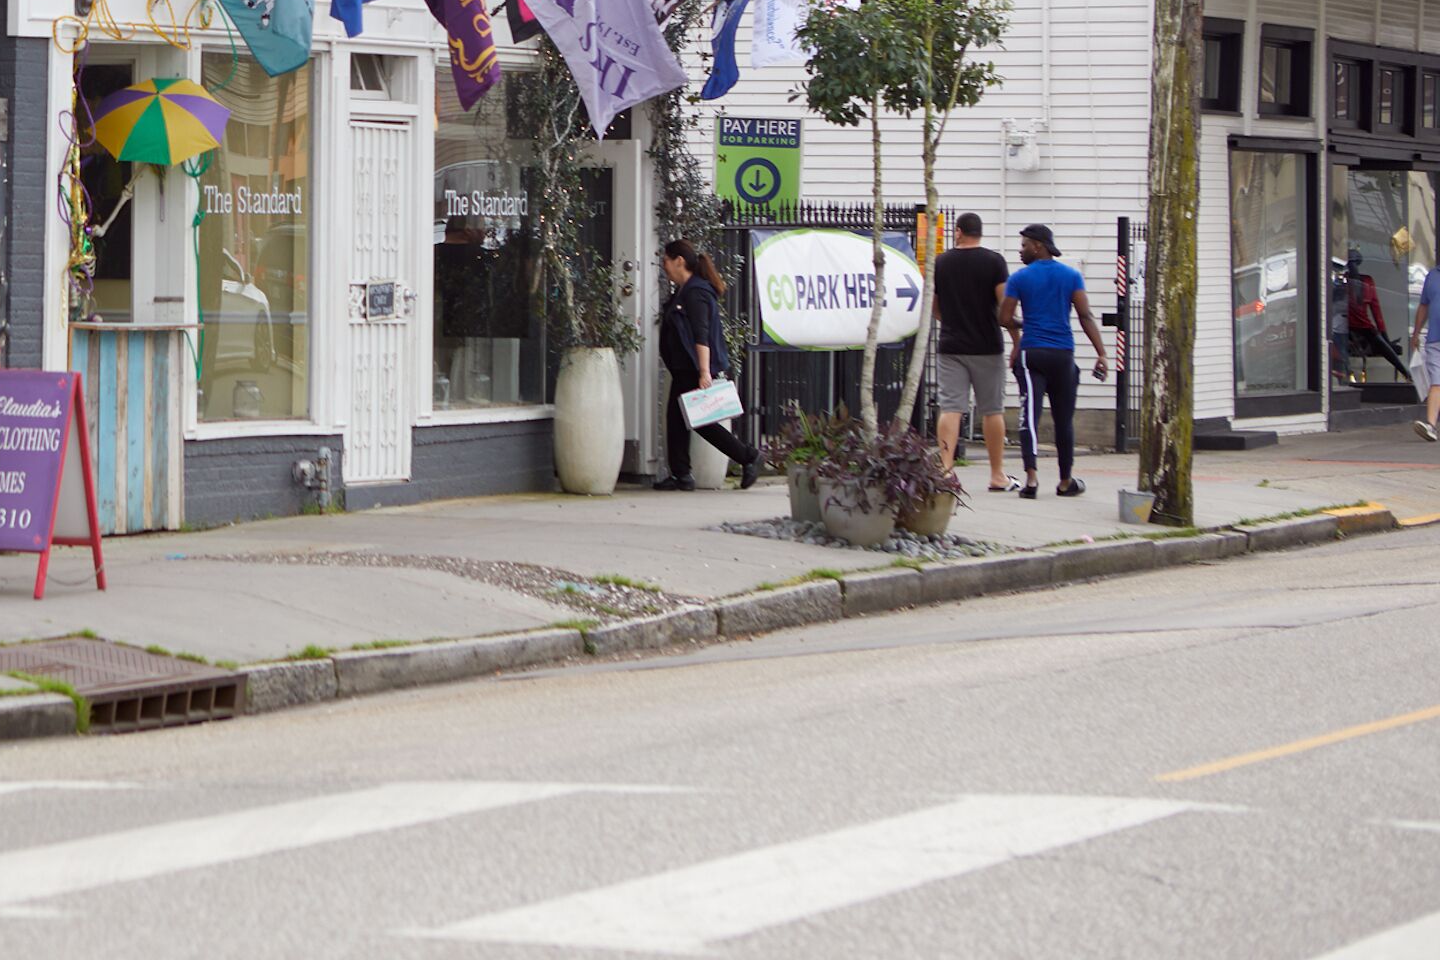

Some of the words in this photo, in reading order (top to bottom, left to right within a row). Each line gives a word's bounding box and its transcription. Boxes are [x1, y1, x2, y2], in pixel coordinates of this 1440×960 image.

[722, 118, 751, 135] PAY
[756, 119, 797, 136] HERE
[722, 136, 743, 145] FOR
[747, 136, 797, 146] PARKING
[204, 185, 232, 214] The
[237, 186, 302, 215] Standard
[445, 189, 469, 216] The
[471, 189, 528, 216] Standard
